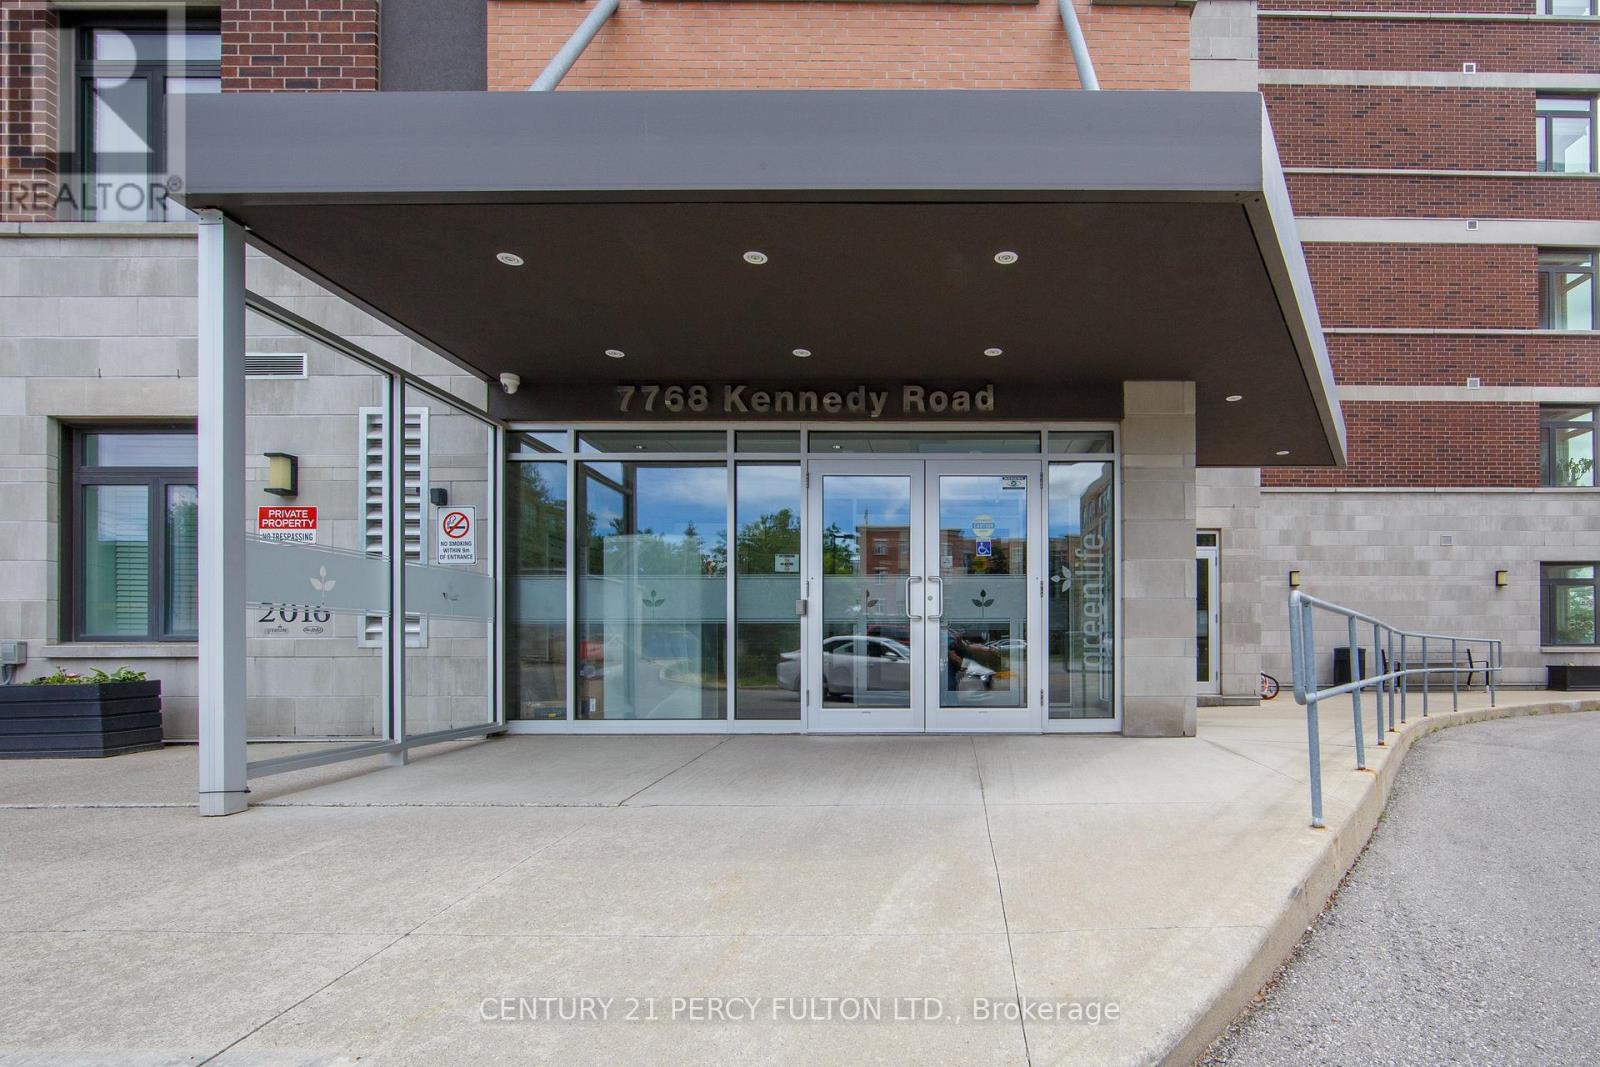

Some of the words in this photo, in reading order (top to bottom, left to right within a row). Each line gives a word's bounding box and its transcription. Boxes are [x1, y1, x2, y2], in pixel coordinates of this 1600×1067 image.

[617, 385, 708, 412] 7768
[724, 385, 888, 418] Kennedy
[903, 384, 994, 413] Road
[262, 519, 314, 528] PROPERTY
[268, 509, 308, 519] PRIVATE
[258, 602, 331, 623] 2016
[1074, 533, 1106, 671] greenlife
